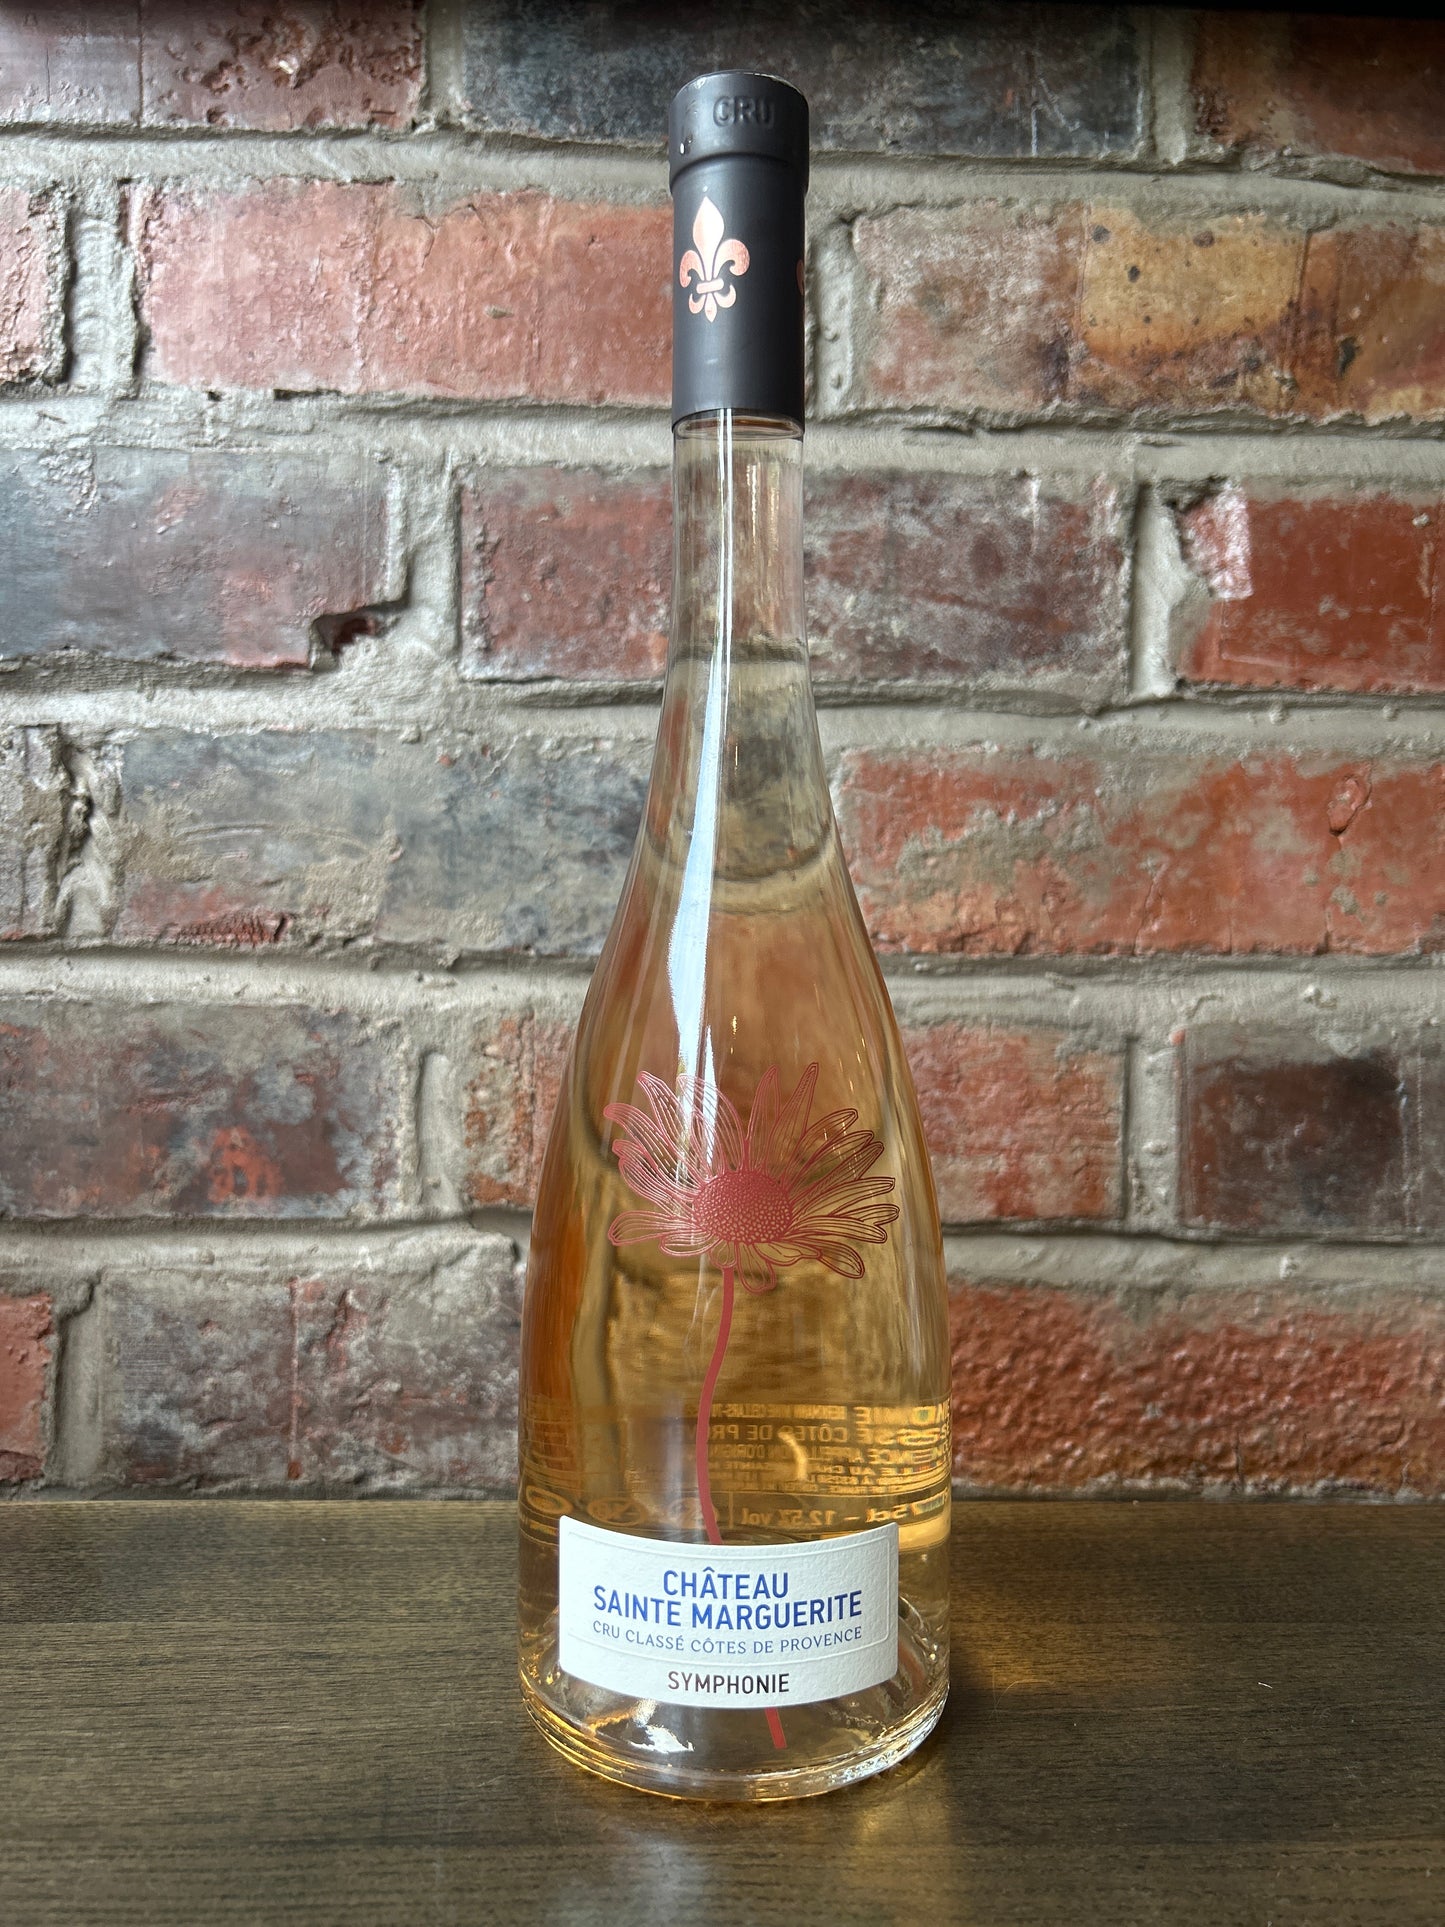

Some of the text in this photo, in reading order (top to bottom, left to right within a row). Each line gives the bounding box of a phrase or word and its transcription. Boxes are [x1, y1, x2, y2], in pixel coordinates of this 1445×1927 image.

[713, 95, 775, 129] CRU
[663, 1566, 789, 1600] CHÂTEAU
[593, 1585, 862, 1630] SAINTE MARGUERITE
[592, 1620, 862, 1654] CRU CLASSÉ CÔTES DE PROVENCE
[667, 1671, 790, 1695] SYMPHONIE
